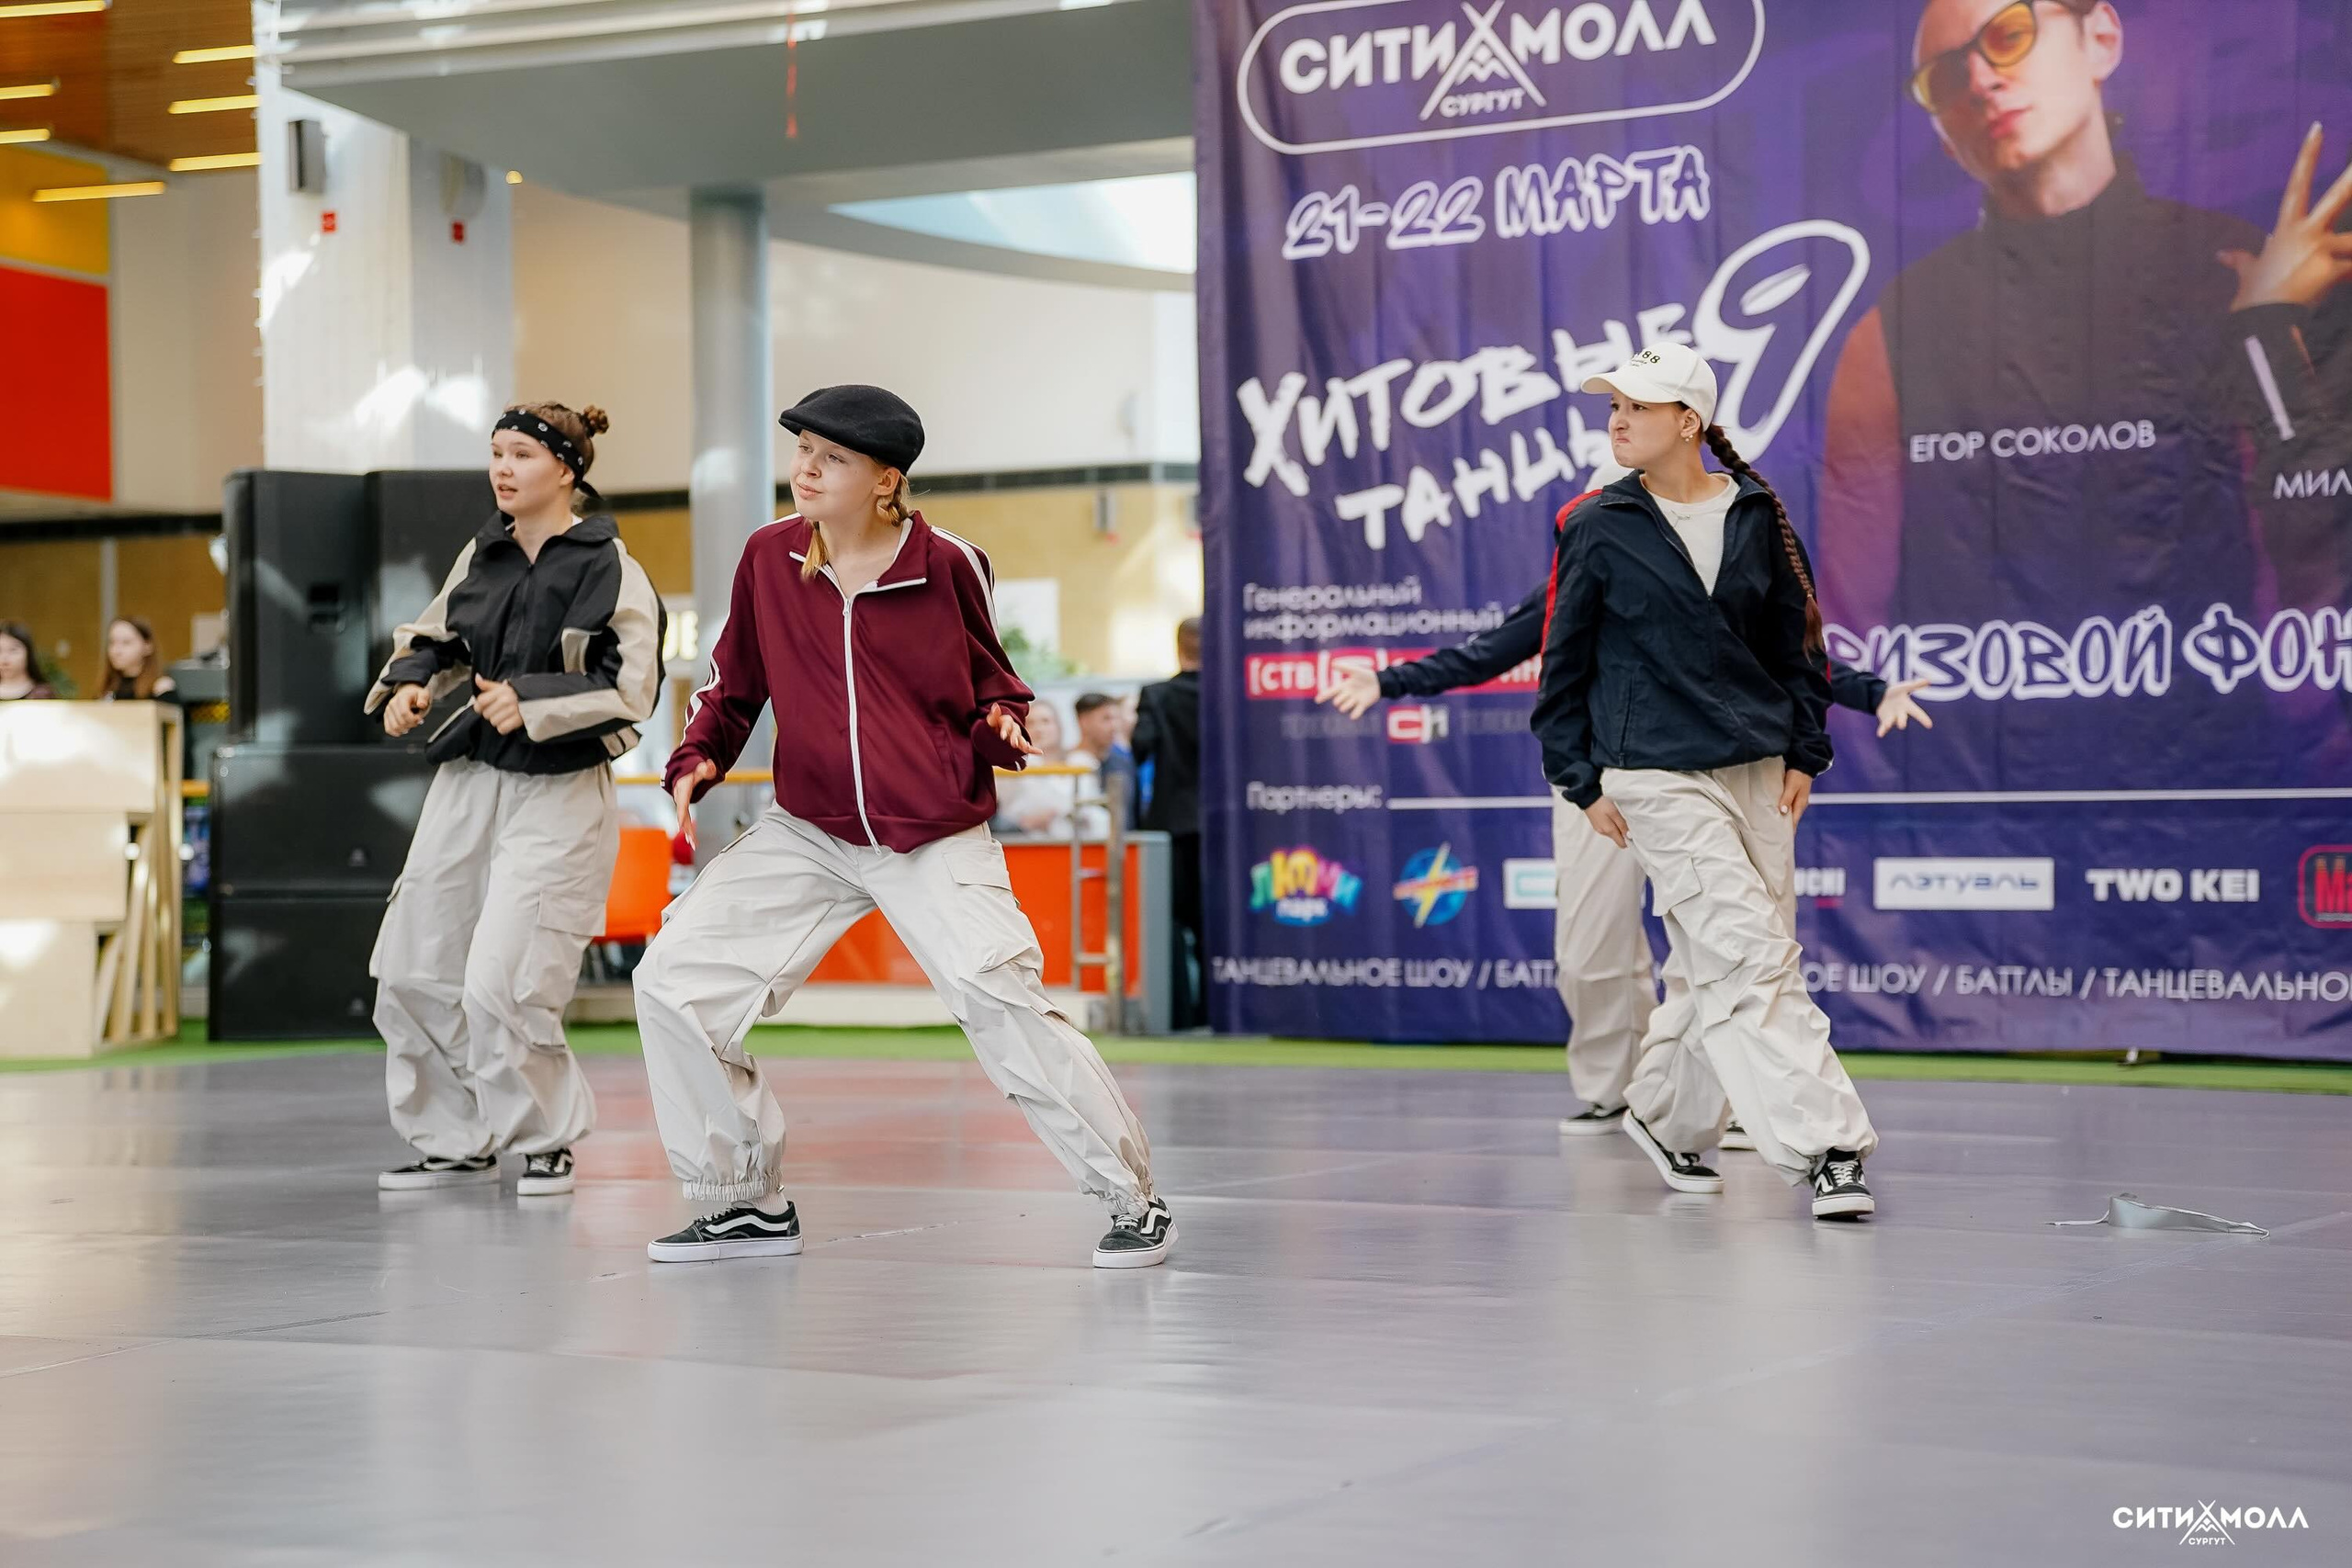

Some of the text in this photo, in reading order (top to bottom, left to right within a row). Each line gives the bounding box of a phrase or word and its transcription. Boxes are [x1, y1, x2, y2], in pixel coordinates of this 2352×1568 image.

[1280, 0, 1717, 94] СИТИ МОЛЛ
[1439, 87, 1527, 118] СУРГУТ
[1283, 145, 1711, 260] 21-22 МАРТА
[1910, 420, 2156, 463] ЕГОР СОКОЛОВ
[1243, 576, 1422, 613] Генеральный
[1822, 604, 2173, 702] РИЗОВОЙ
[2085, 868, 2260, 902] TWO KEI
[1212, 956, 1404, 987] ТАНЦЕВАЛЬНОЕ
[1404, 958, 1475, 987] ШОУ
[1849, 963, 1928, 994] ШОУ
[1955, 964, 2074, 996] БАТТЛЫ
[2102, 966, 2352, 1002] ТАНЦЕВАЛЬНО
